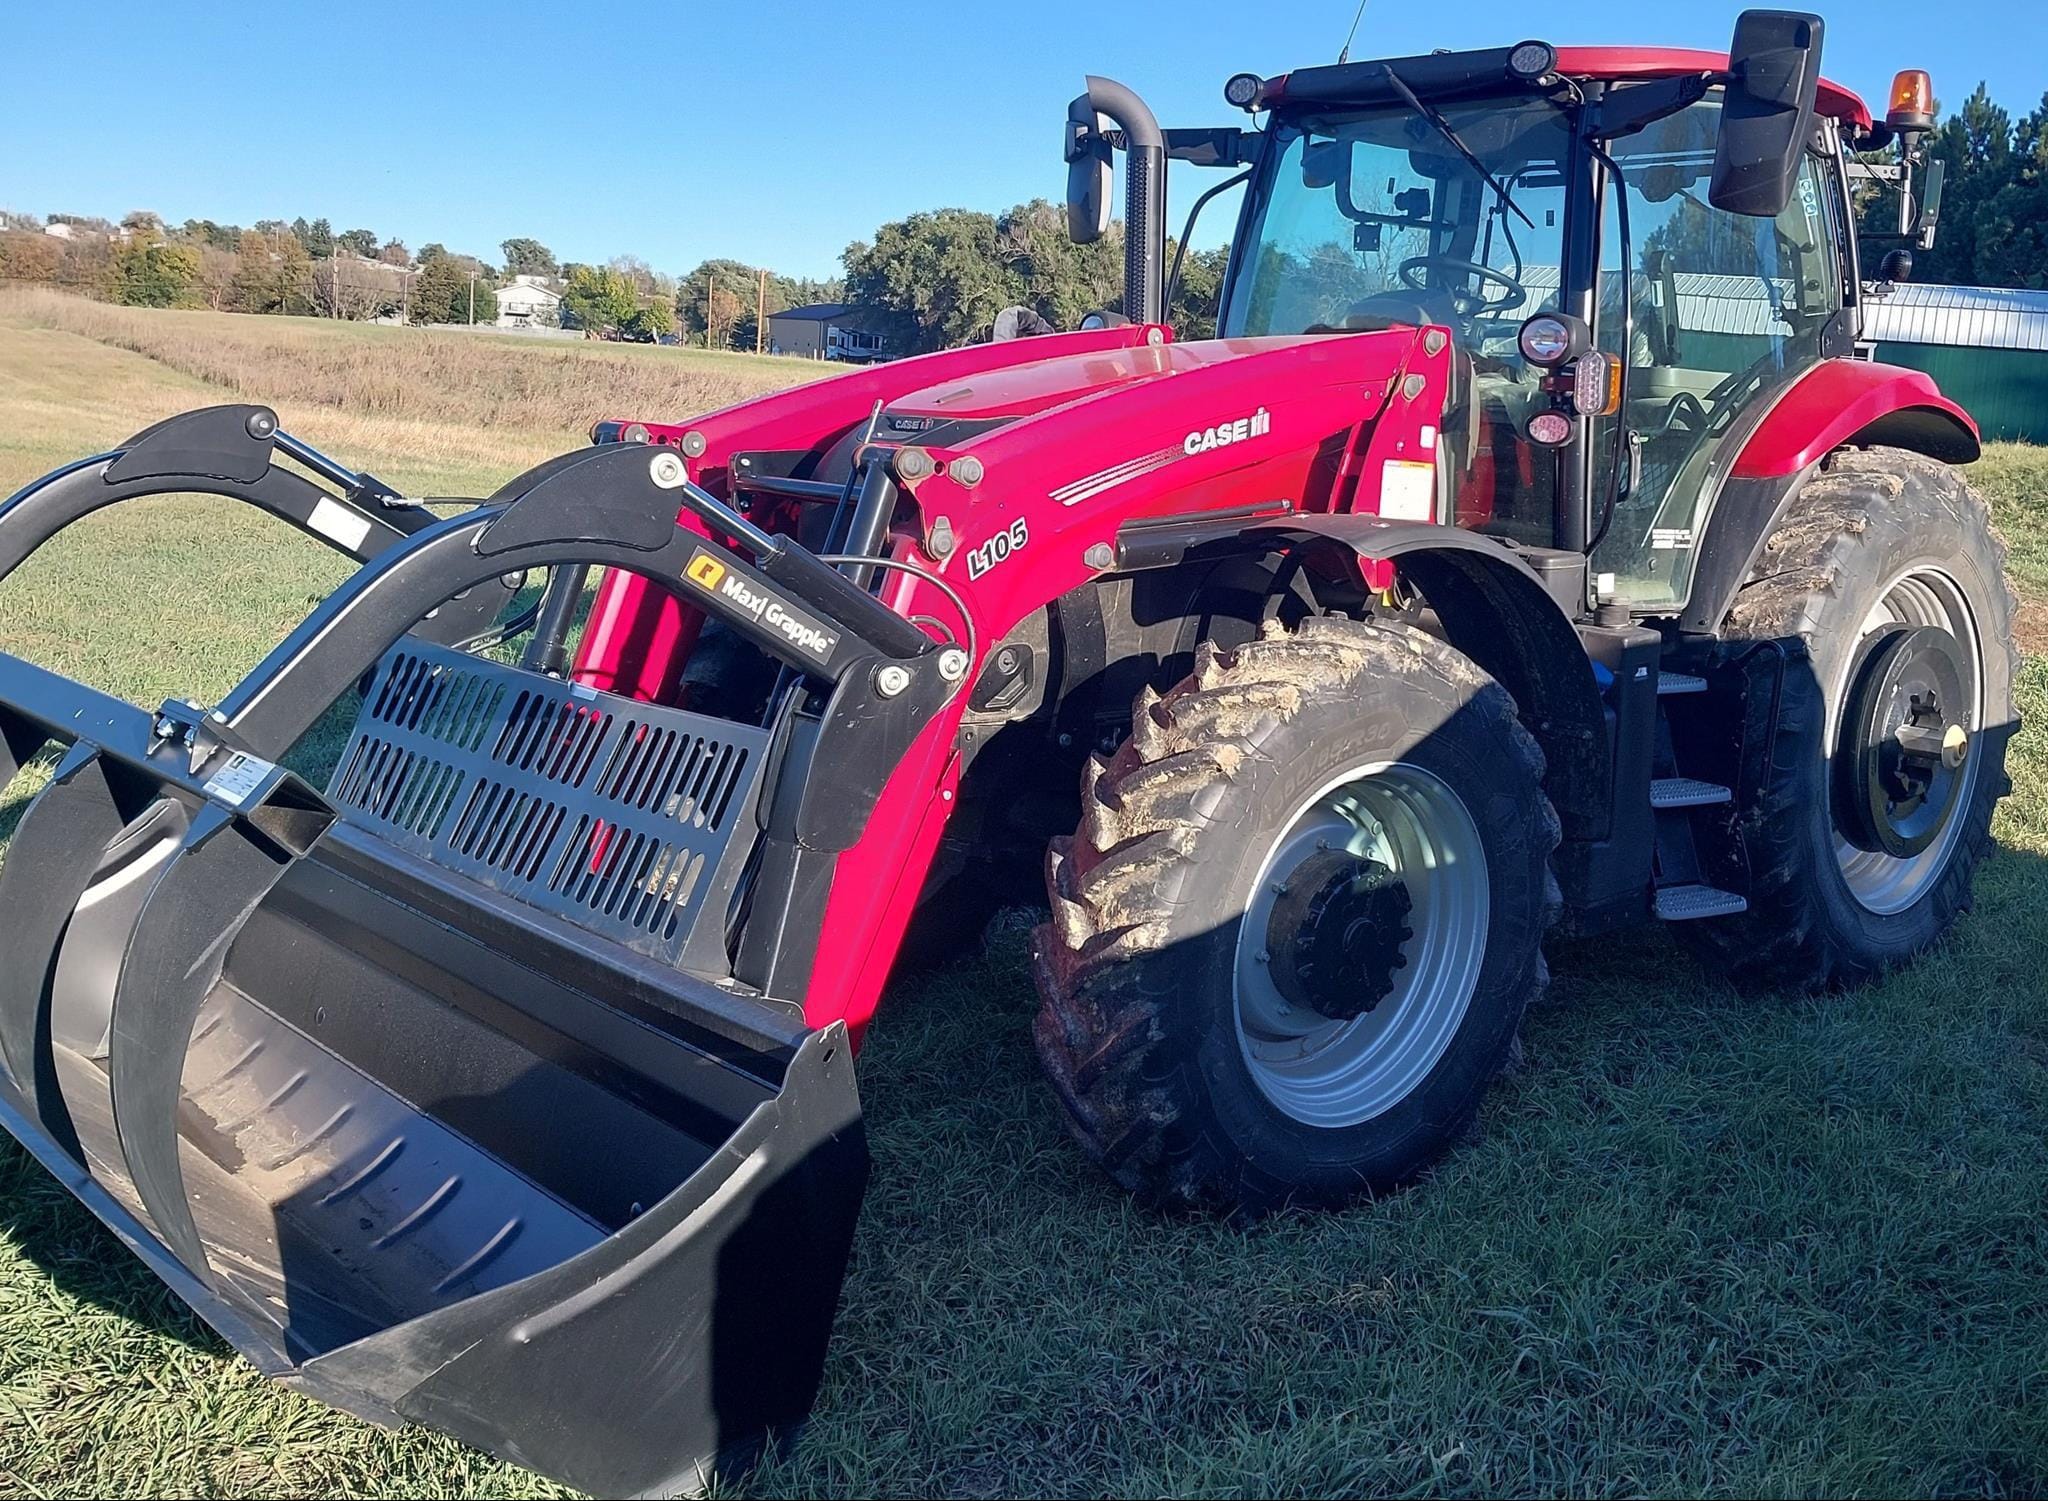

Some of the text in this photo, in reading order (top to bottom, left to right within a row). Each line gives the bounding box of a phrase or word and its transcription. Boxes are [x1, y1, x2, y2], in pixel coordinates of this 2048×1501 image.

[895, 420, 921, 430] CASE
[1184, 418, 1249, 456] CASE
[966, 516, 1029, 581] L105
